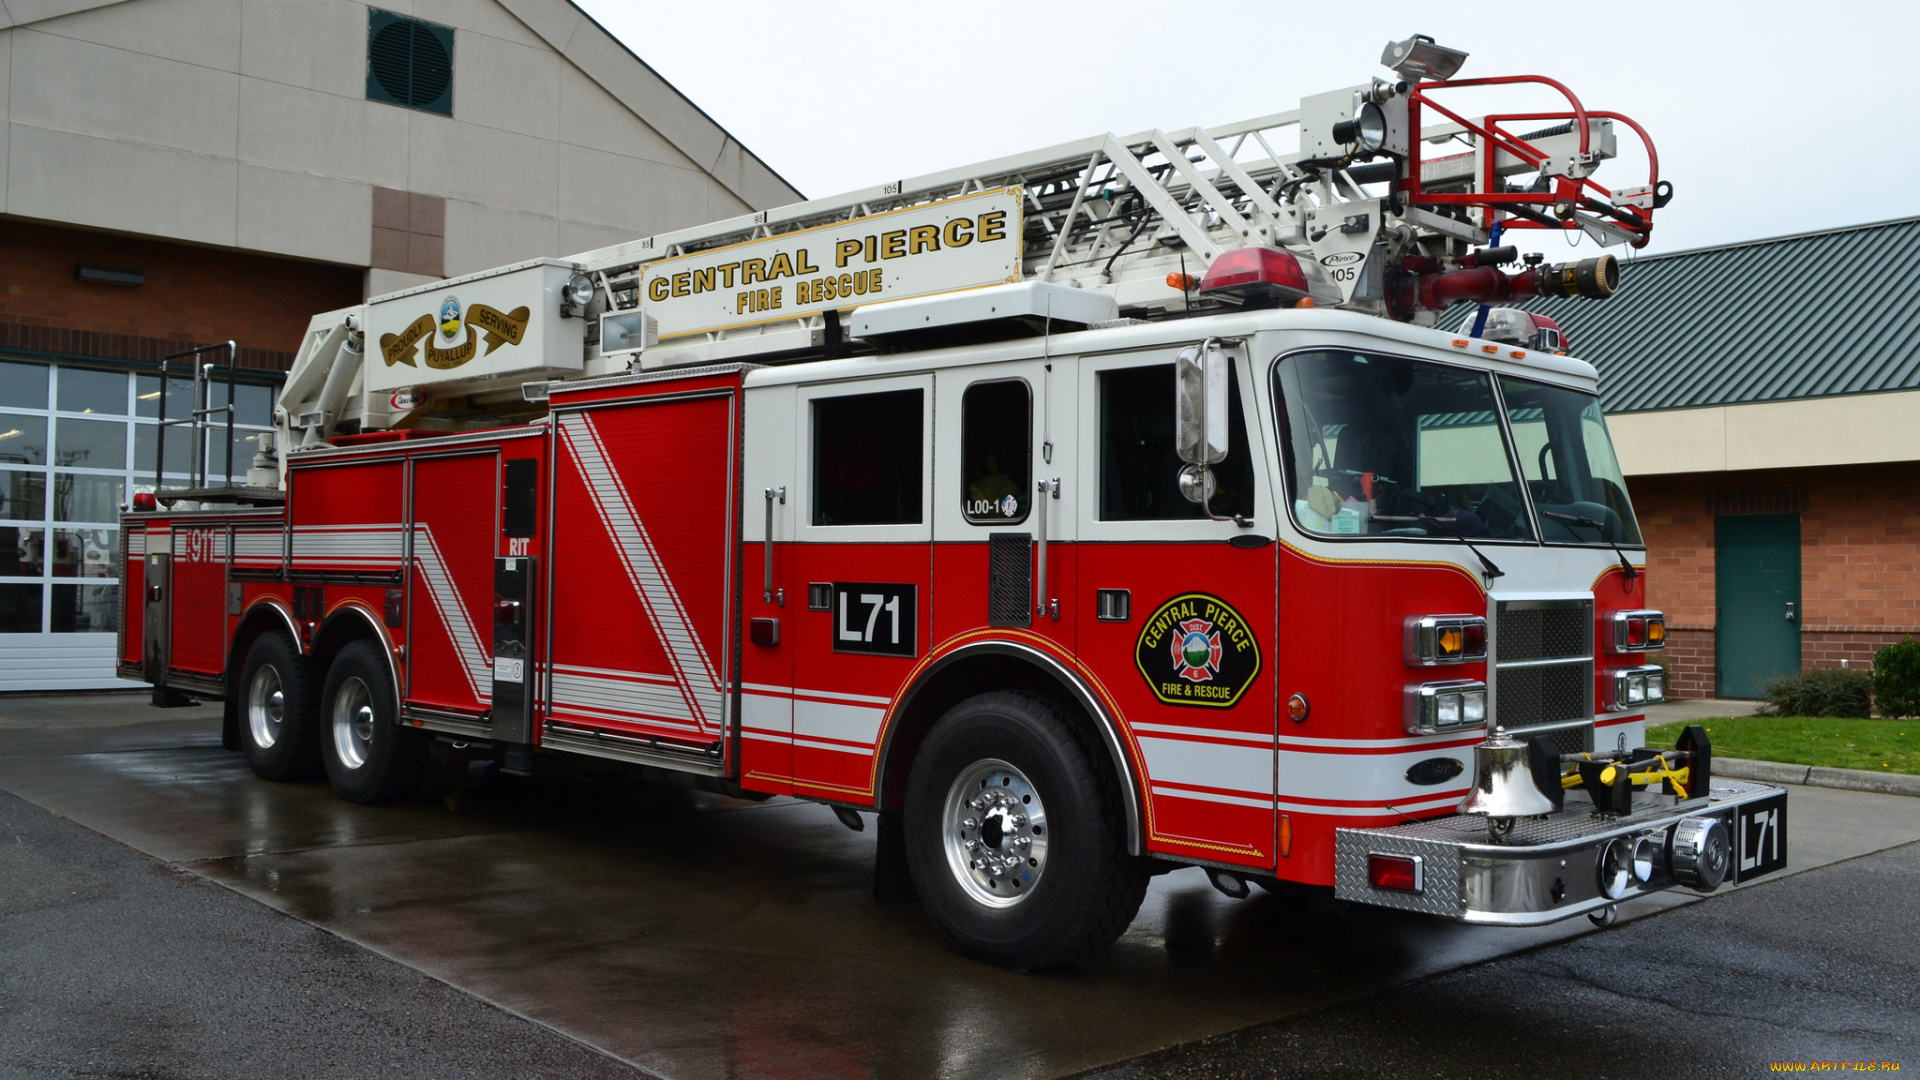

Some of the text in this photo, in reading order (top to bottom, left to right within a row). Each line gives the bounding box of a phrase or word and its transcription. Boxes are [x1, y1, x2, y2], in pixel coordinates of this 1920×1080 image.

[883, 184, 897, 195] 105
[754, 215, 763, 224] 95
[648, 210, 1007, 302] CENTRAL PIERCE
[1328, 254, 1355, 265] Pierce
[736, 268, 883, 315] FIRE RESCUE
[387, 308, 518, 362] PROUDLY PUYALLUP SERVING
[192, 528, 214, 563] 911
[509, 537, 530, 556] RIT
[839, 591, 900, 644] L71
[1145, 601, 1251, 653] CENTRAL PIERCE
[1162, 683, 1231, 699] FIRE & RESCUE
[1193, 669, 1199, 678] 6
[1740, 808, 1778, 872] L71
